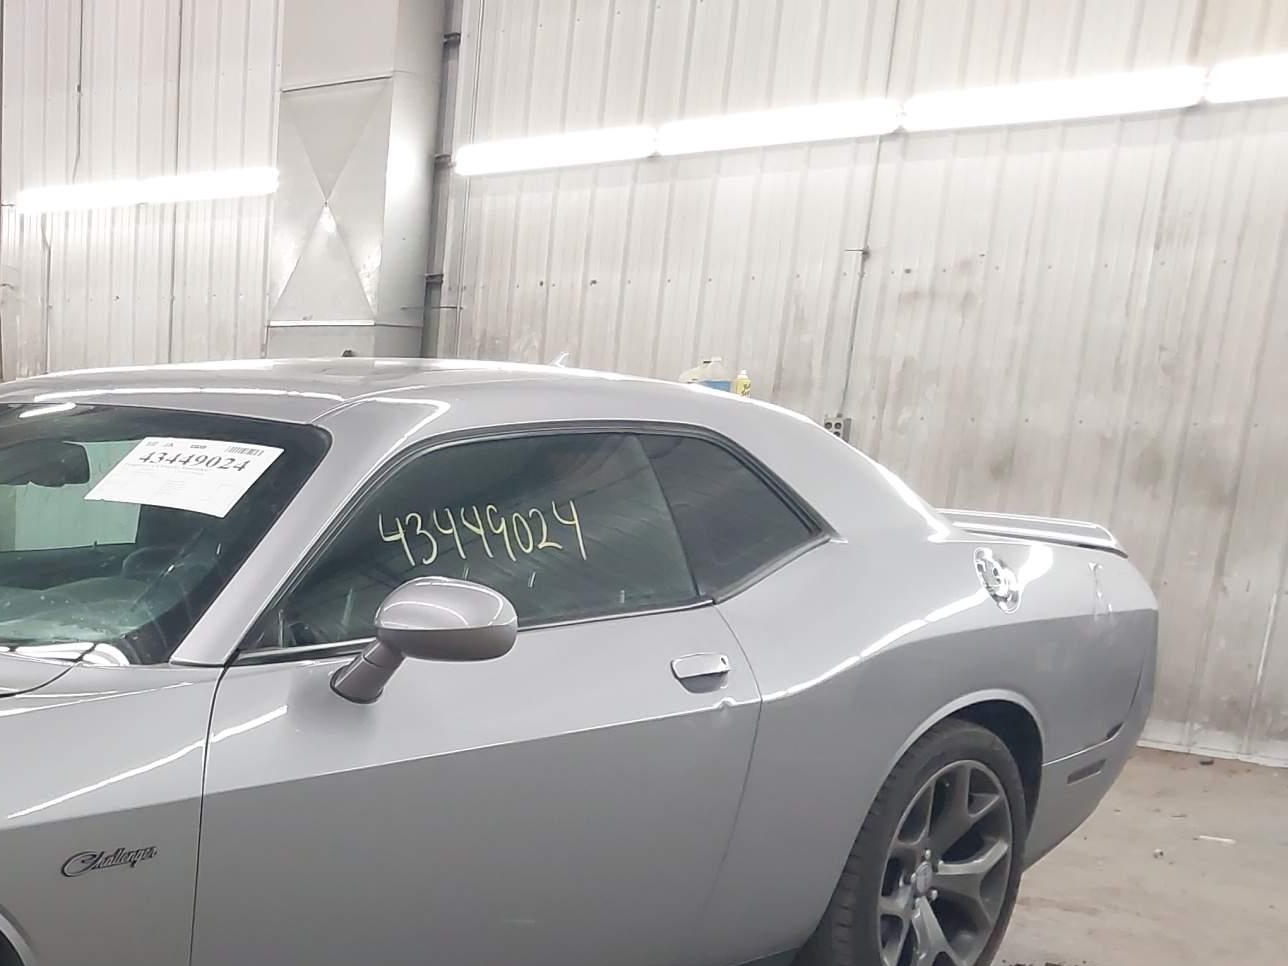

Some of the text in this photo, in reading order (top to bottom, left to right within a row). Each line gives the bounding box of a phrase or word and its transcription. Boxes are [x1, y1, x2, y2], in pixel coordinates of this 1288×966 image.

[139, 451, 251, 472] 43449024
[378, 500, 587, 567] 43449024
[60, 846, 158, 878] Challenger
